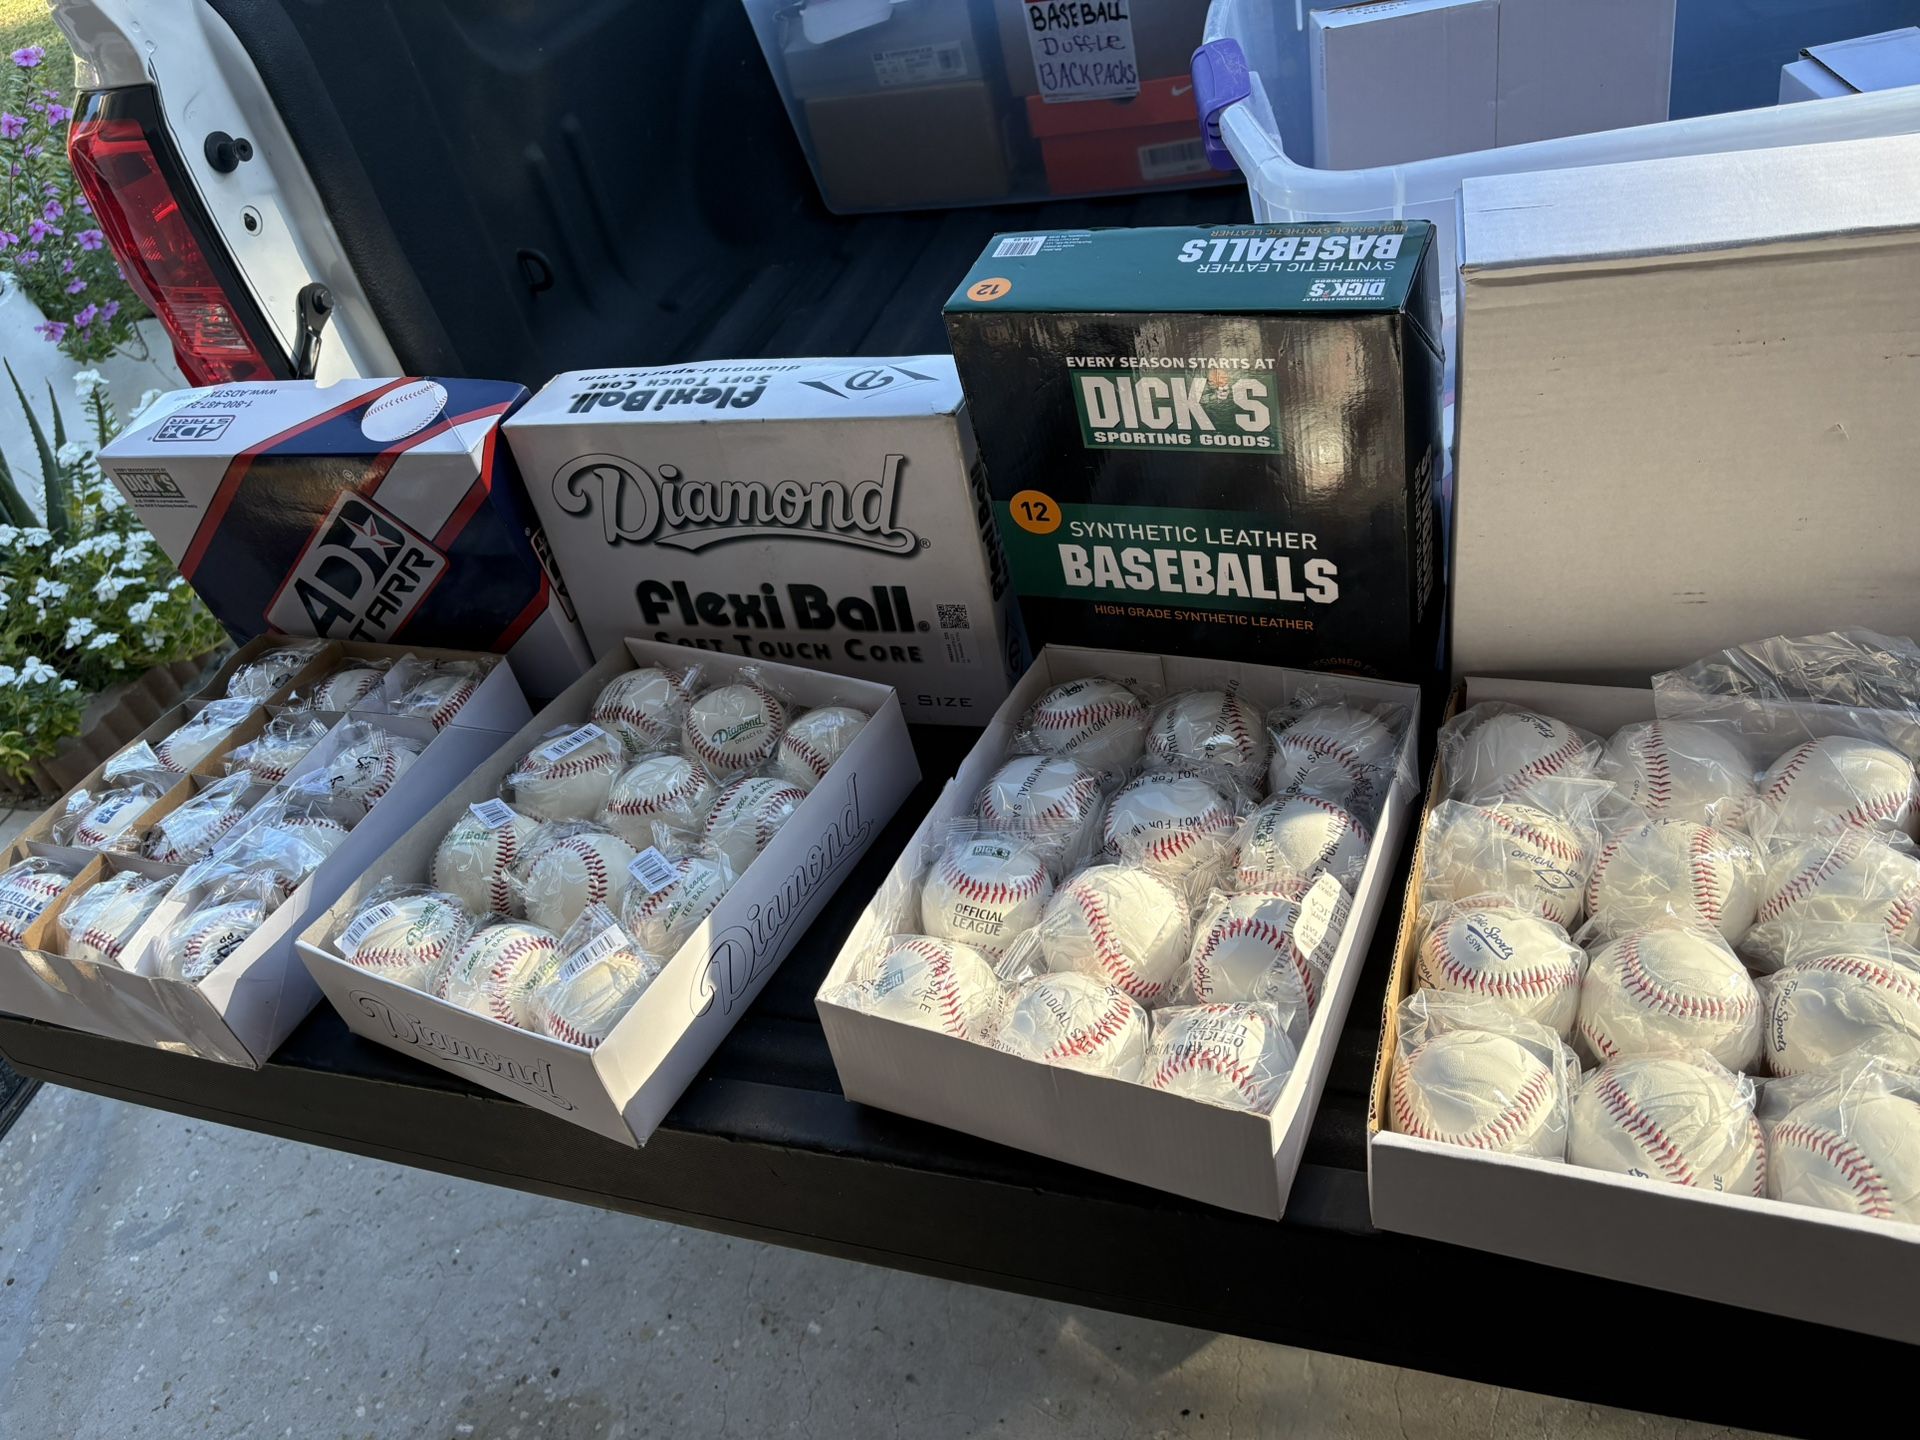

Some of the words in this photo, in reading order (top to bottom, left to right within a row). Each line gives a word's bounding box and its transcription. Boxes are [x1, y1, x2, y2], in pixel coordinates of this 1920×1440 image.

[1030, 1, 1128, 32] BASEBALL
[1210, 228, 1263, 237] LEATHER
[1265, 227, 1331, 236] SYNTHETIC
[1177, 234, 1404, 263] BASEBALLS
[1198, 262, 1282, 273] LEATHER
[1285, 261, 1397, 272] SYNTHETIC
[976, 283, 1001, 296] 12
[577, 364, 801, 383] diamond-sports.com
[1066, 356, 1116, 369] EVERY
[1119, 356, 1184, 370] SEASON
[1188, 356, 1249, 370] STARTS
[1253, 357, 1276, 370] AT
[1079, 375, 1272, 434] DICK'S
[169, 417, 231, 426] STARR
[1093, 431, 1192, 447] SPORTING
[1200, 433, 1273, 448] GOODS
[550, 451, 919, 560] Diamond
[1020, 500, 1051, 523] 12
[1069, 520, 1198, 544] SYNTHETIC
[1204, 528, 1318, 551] LEATHER
[1058, 543, 1340, 604] BASEBALLS
[349, 546, 437, 642] TARR
[1094, 604, 1126, 617] HIGH
[1127, 606, 1172, 620] GRADE
[1174, 610, 1248, 626] SYNTHETIC
[1250, 615, 1315, 632] LEATHER
[711, 713, 767, 745] Diamond
[1511, 848, 1555, 871] OFFICIAL
[681, 900, 694, 919] TEE
[691, 882, 711, 905] BALL
[688, 771, 872, 1019] Diamond
[954, 902, 1004, 923] OFFICIAL
[952, 915, 1002, 937] LEAGUE
[1469, 912, 1488, 932] Epic
[1484, 925, 1515, 963] Sports
[1464, 932, 1484, 953] E-SYN
[1775, 1002, 1789, 1054] Sports
[348, 988, 574, 1111] Diamond
